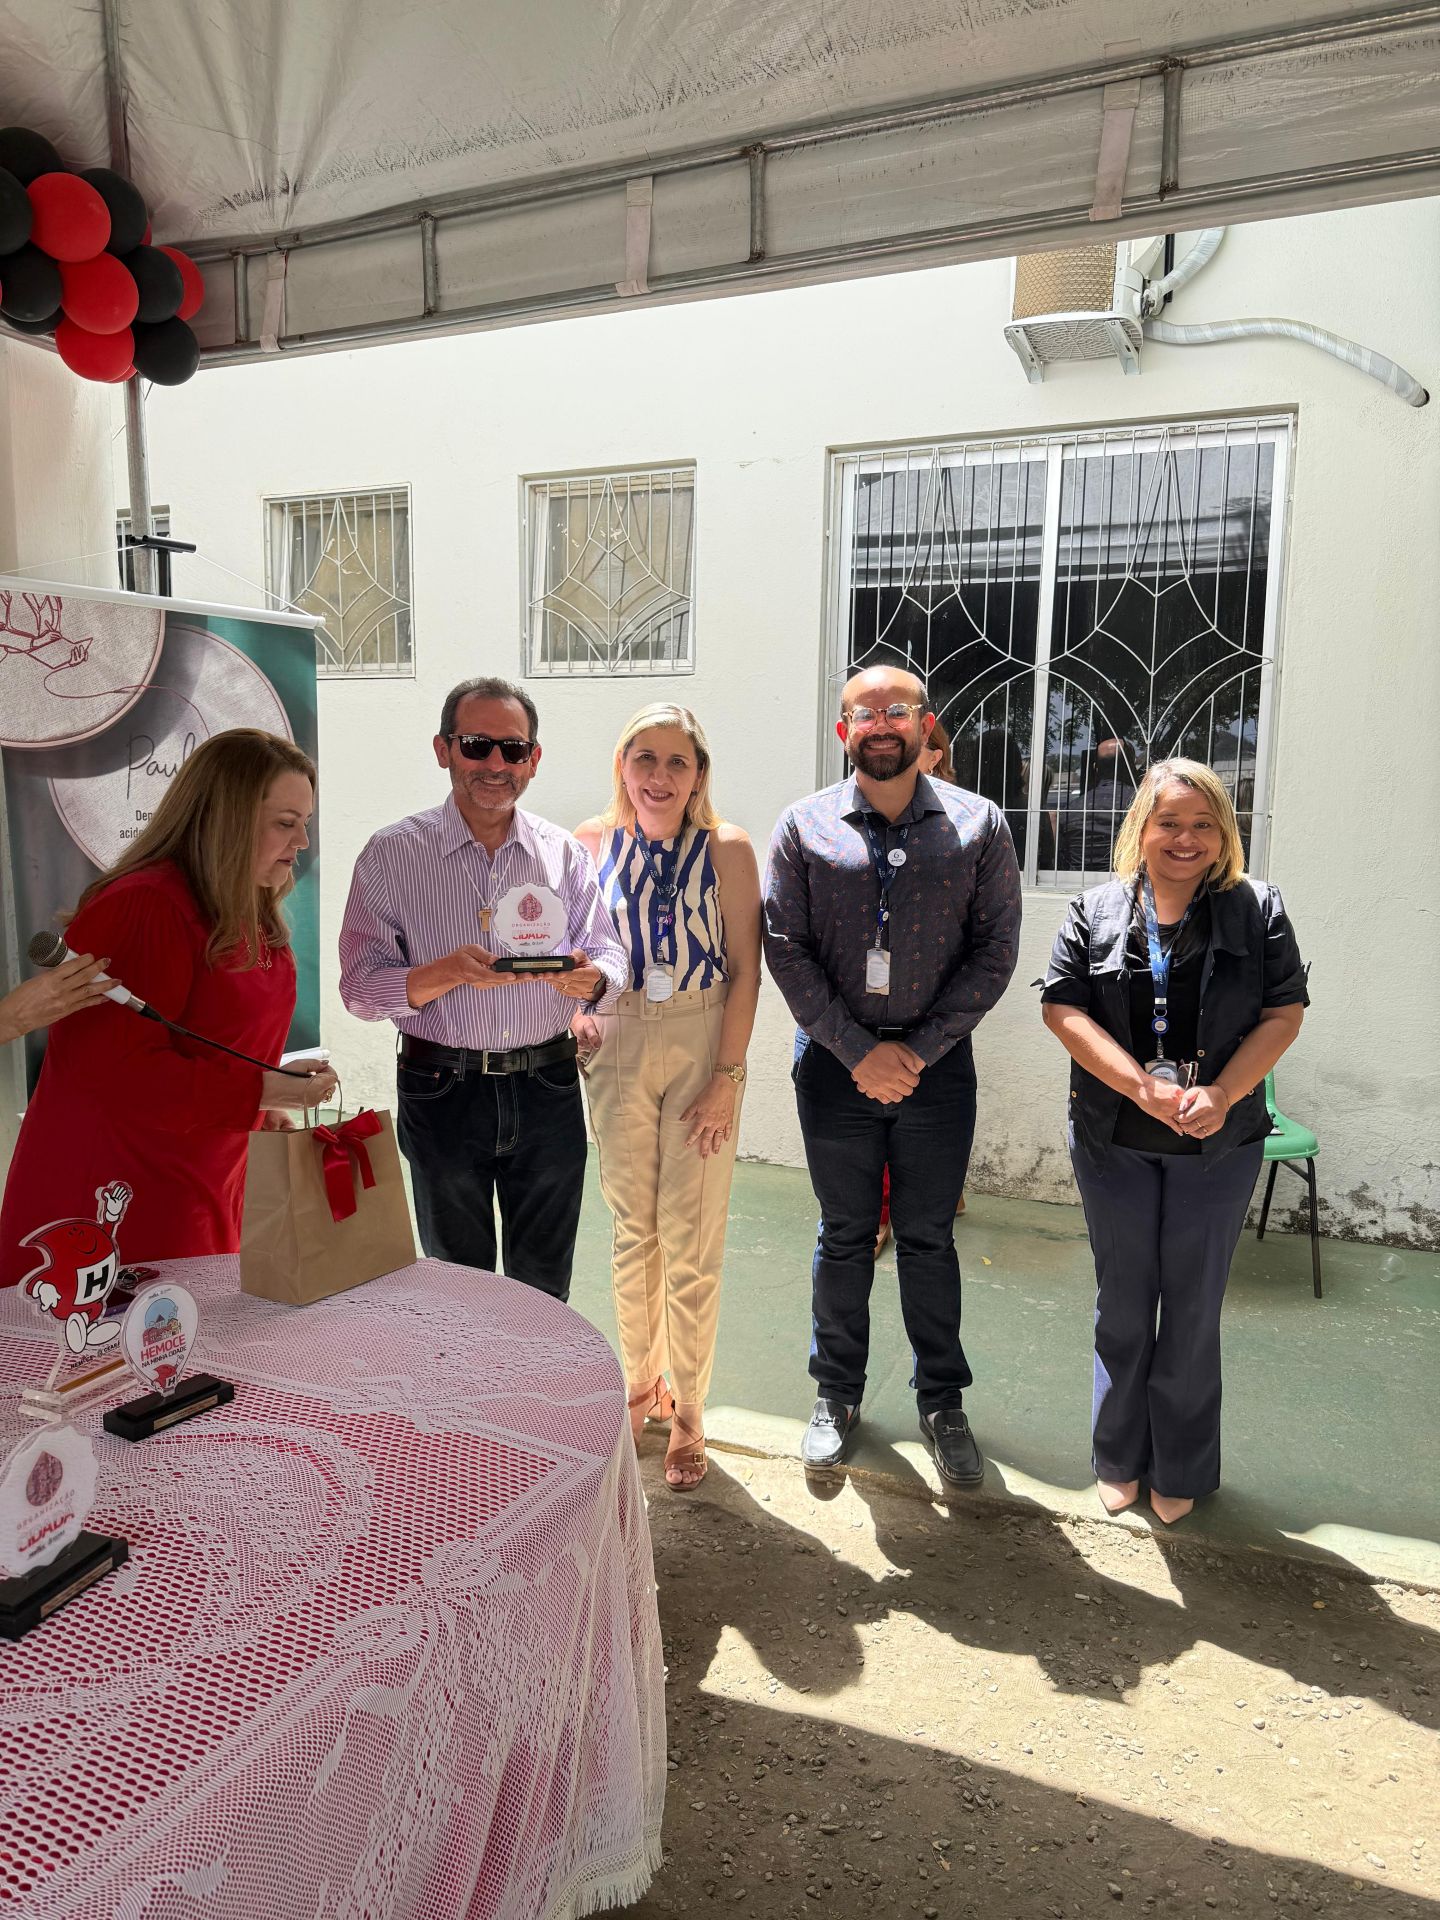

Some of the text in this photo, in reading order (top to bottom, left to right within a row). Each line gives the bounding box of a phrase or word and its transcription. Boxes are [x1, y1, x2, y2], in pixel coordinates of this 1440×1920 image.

[127, 732, 196, 800] Paul
[84, 1264, 109, 1298] H
[140, 1334, 186, 1361] HEMOCE
[141, 1345, 187, 1369] NA MINHA CIDADE
